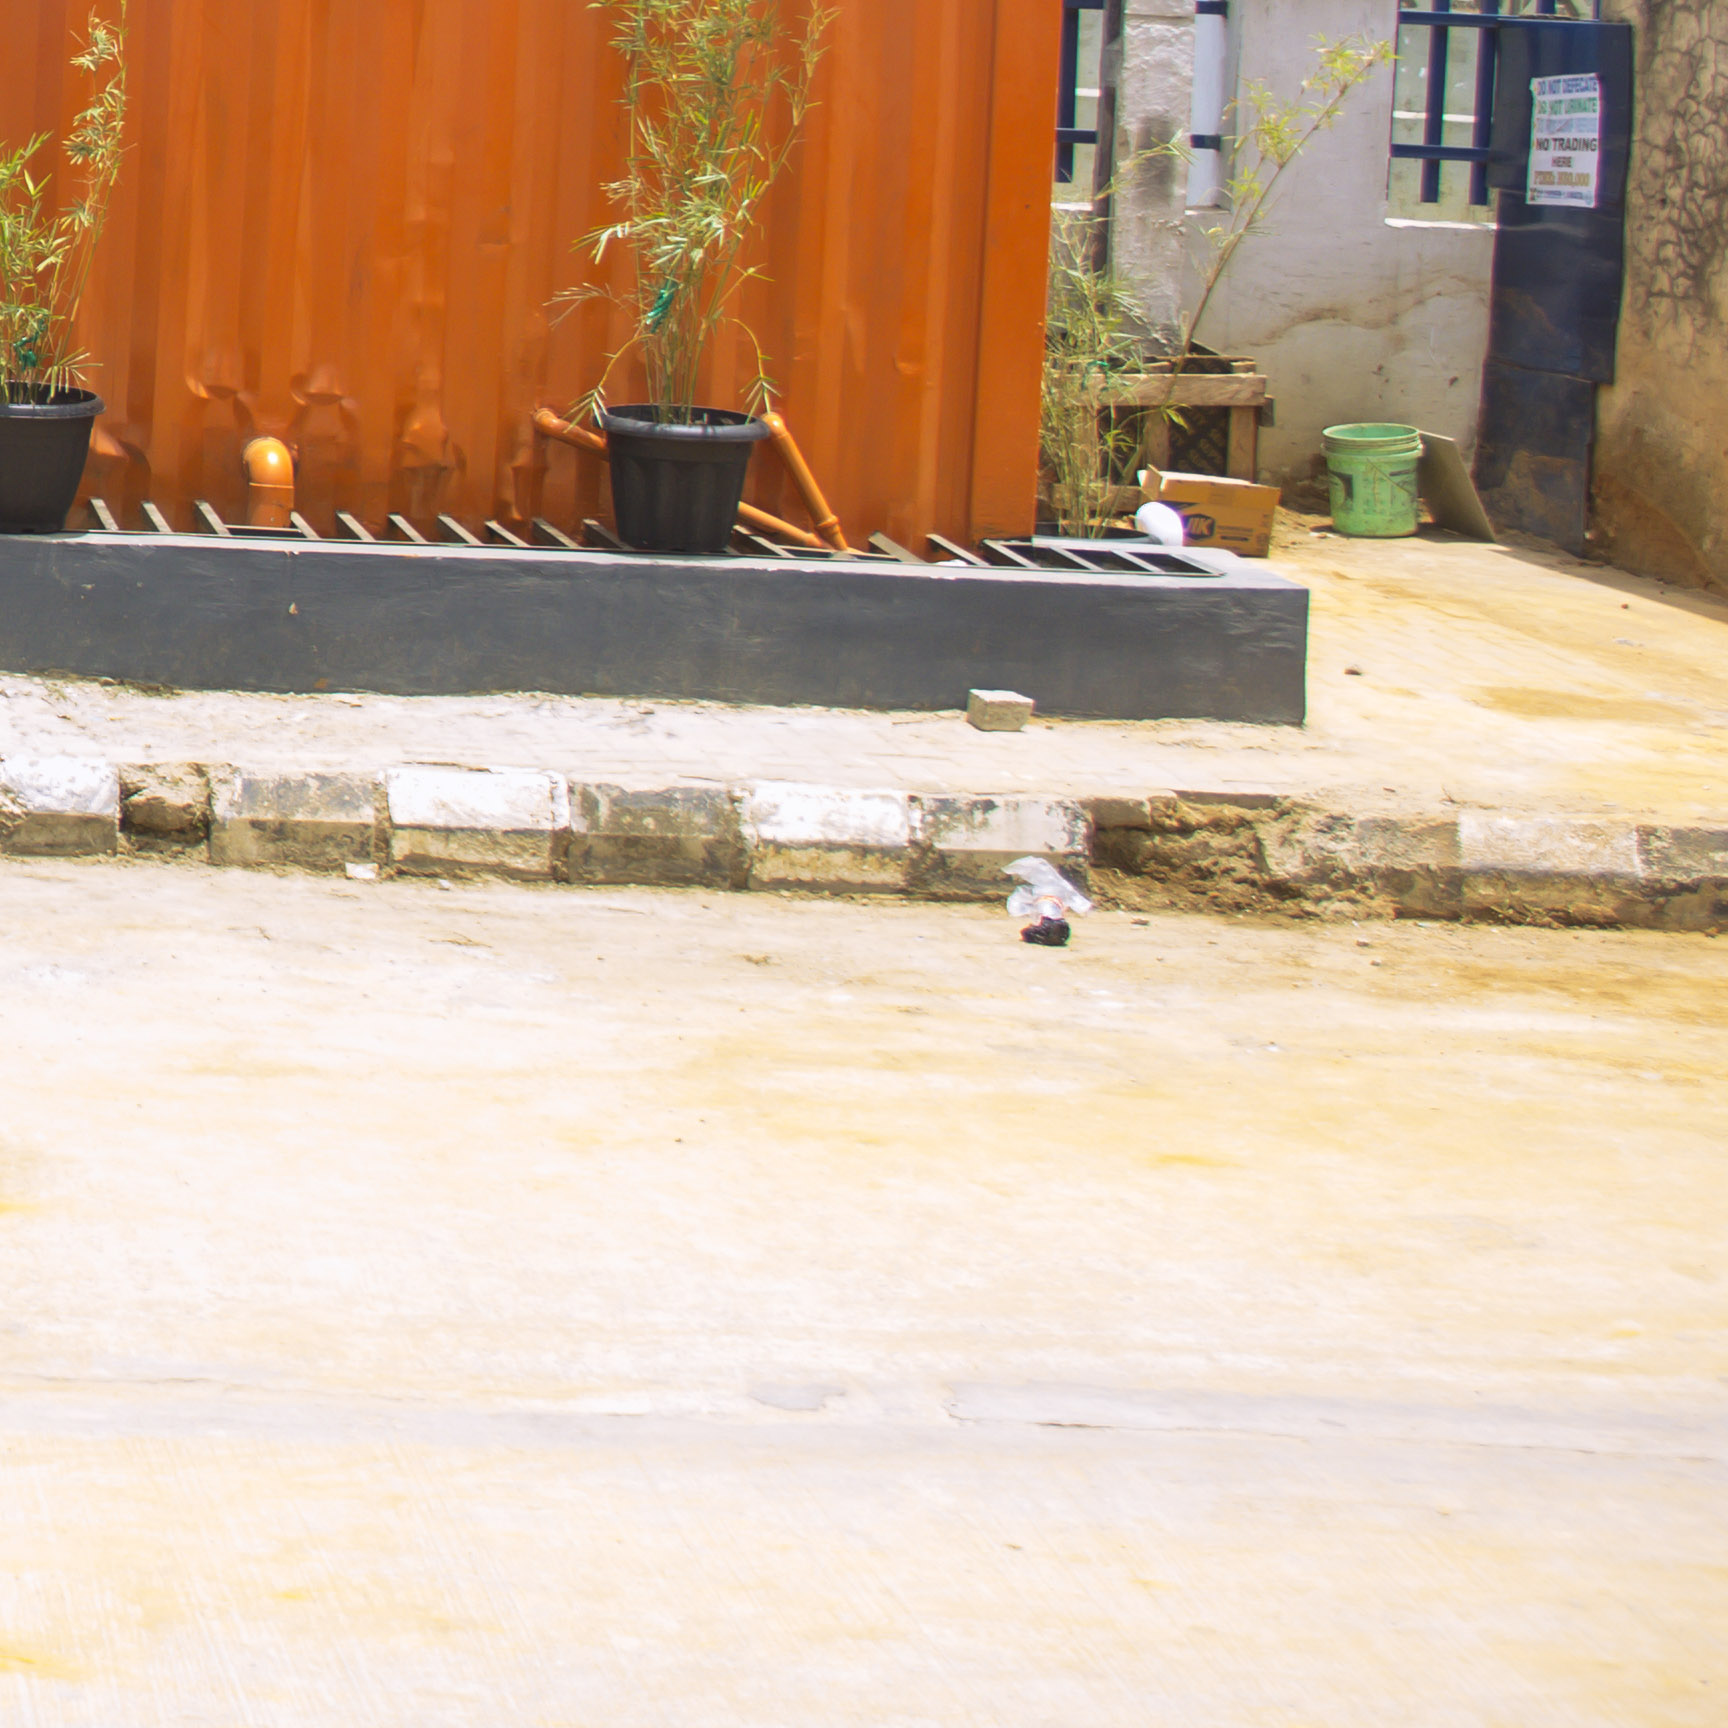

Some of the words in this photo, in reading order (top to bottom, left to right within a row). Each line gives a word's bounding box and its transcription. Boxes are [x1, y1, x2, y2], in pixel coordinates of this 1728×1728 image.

[1536, 138, 1549, 151] NO
[1552, 138, 1598, 151] TRADING
[1552, 156, 1572, 168] HERE
